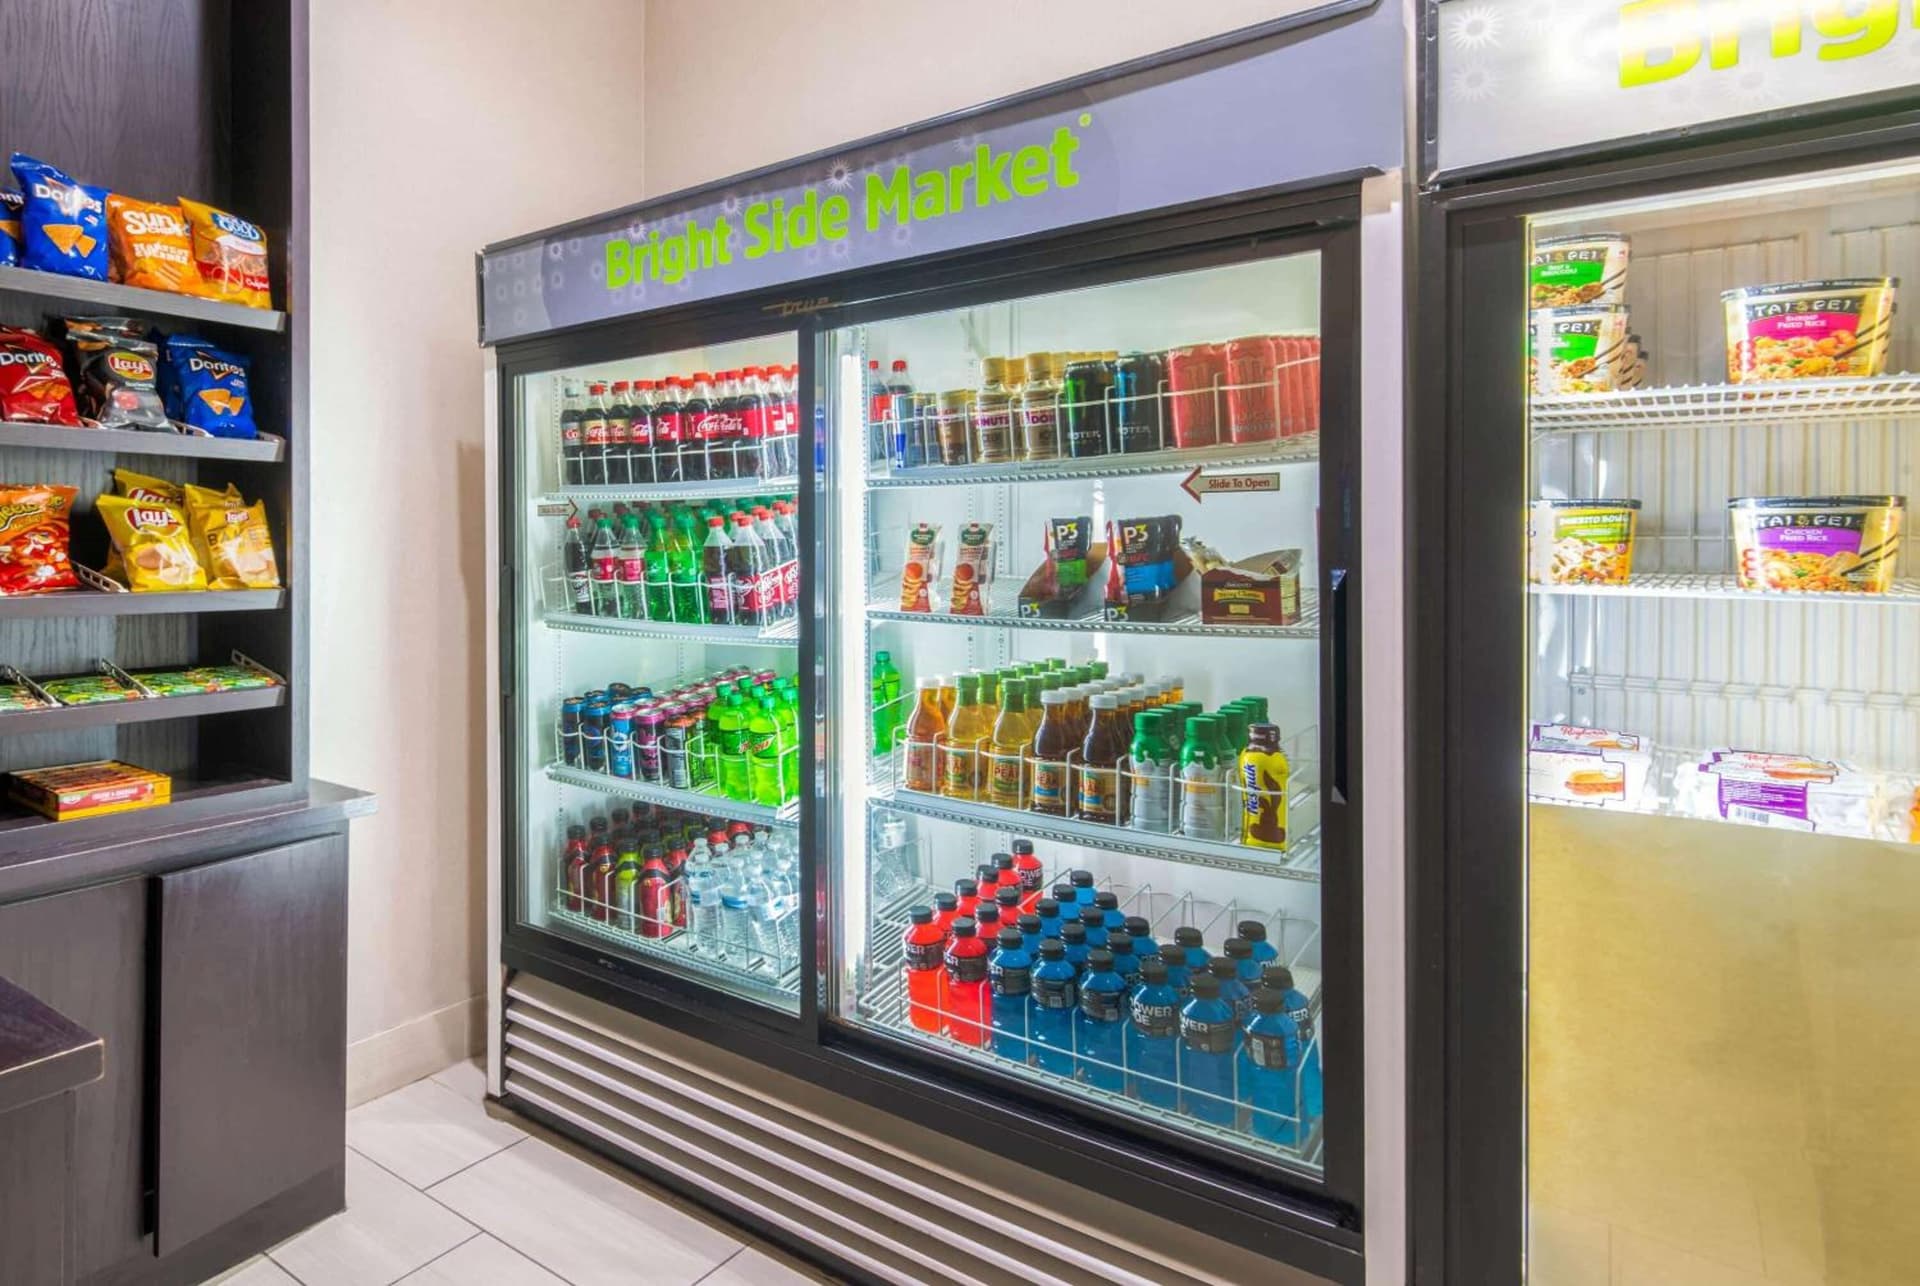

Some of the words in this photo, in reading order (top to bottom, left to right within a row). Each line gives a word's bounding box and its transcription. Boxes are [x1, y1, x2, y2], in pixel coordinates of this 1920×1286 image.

[1619, 0, 1920, 89] Brig
[605, 215, 732, 290] Bright
[743, 189, 849, 260] Side
[865, 127, 1080, 232] Market
[190, 358, 246, 377] Doritos
[1208, 478, 1230, 489] Slide
[1232, 478, 1243, 488] To
[1245, 478, 1270, 489] Open
[1056, 522, 1079, 541] P3
[1123, 523, 1148, 544] P3
[1020, 602, 1041, 618] P3
[1107, 606, 1128, 622] P3
